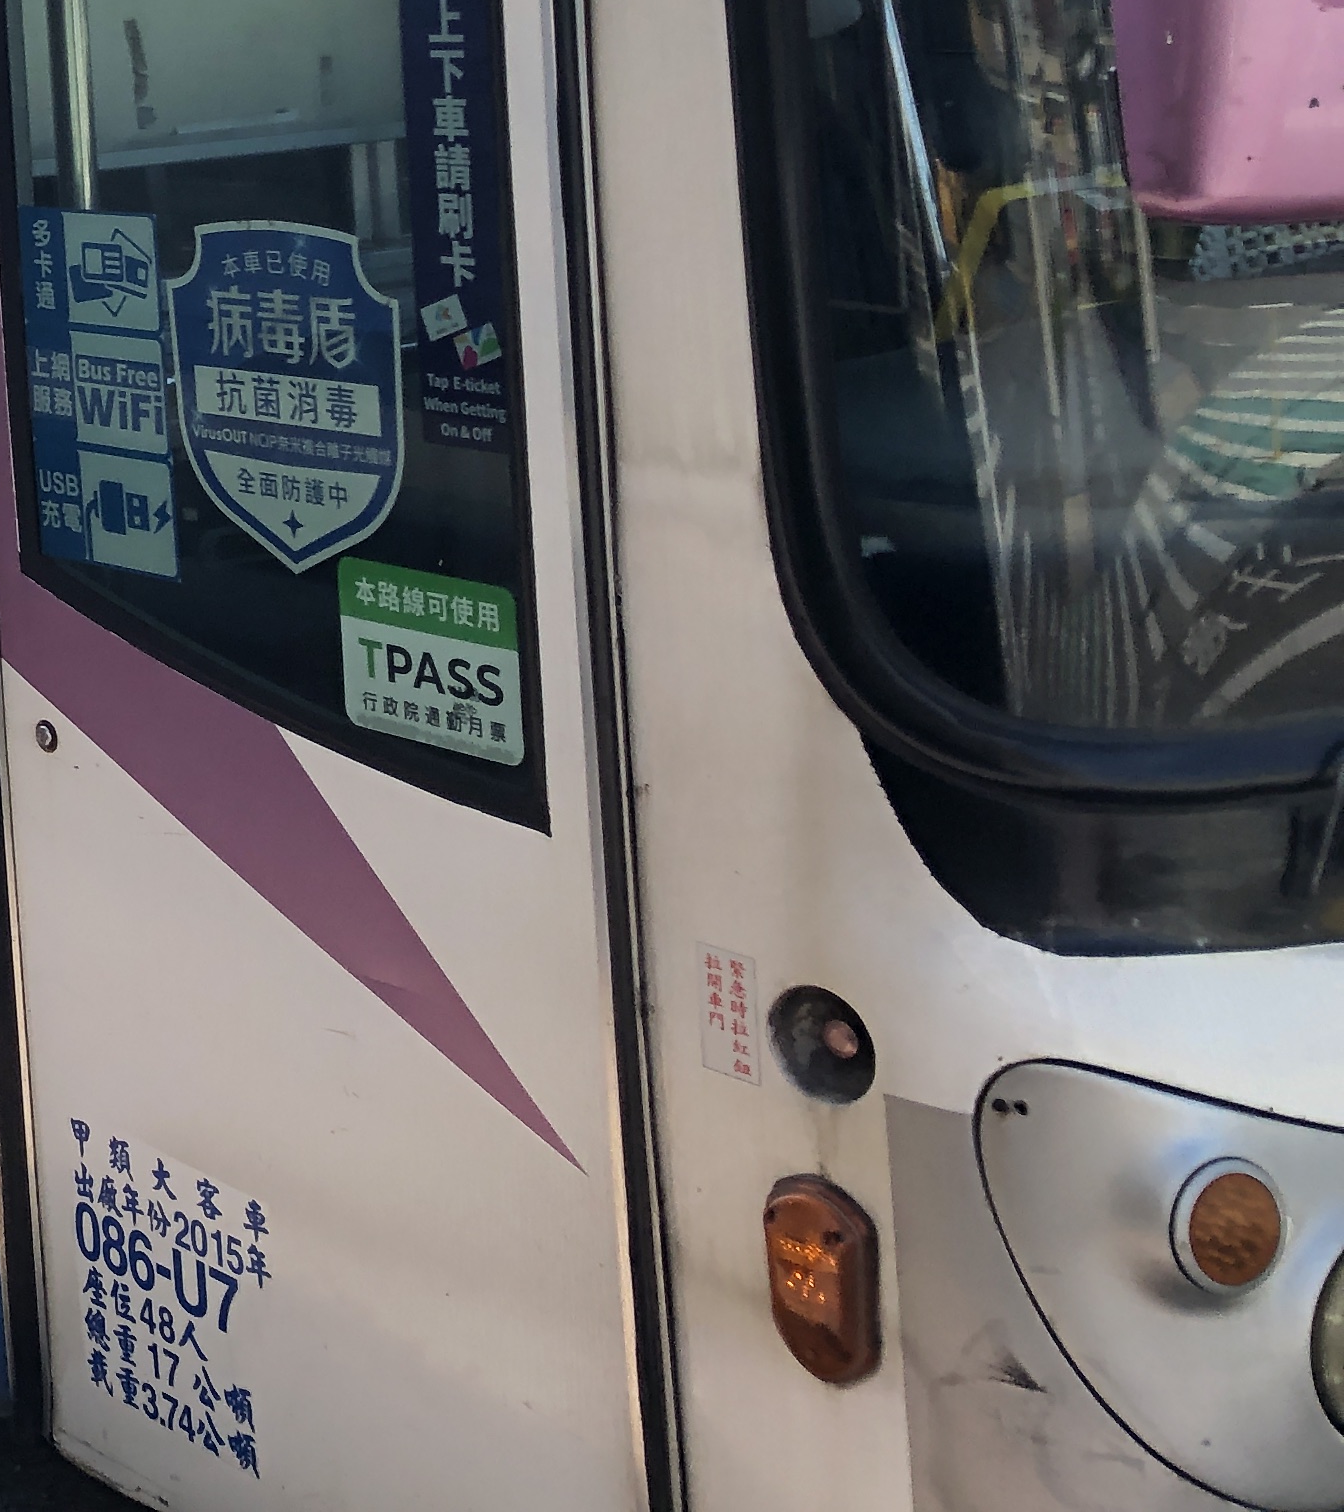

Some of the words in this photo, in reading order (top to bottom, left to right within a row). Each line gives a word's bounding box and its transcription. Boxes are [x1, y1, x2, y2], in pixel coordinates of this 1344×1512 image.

[31, 219, 57, 311] 多卡通
[221, 249, 332, 288] 本車已使用
[205, 284, 357, 369] 病毒盾
[30, 348, 71, 381] 上網
[78, 358, 111, 381] Bus
[116, 364, 159, 389] Free
[426, 372, 449, 390] Tap
[453, 376, 501, 395] E-ticket
[32, 384, 74, 418] 服務
[76, 384, 165, 436] WiFi
[215, 370, 358, 430] 抗菌消毒
[423, 396, 459, 414] When
[460, 401, 507, 424] Getting
[192, 423, 248, 446] VirusOUT
[440, 422, 459, 437] On
[460, 424, 471, 439] &
[472, 426, 494, 442] Off
[38, 468, 80, 498] USB
[236, 467, 349, 510] 全面防護中
[41, 499, 83, 535] 充電
[354, 576, 502, 633] 本路線可使用
[358, 637, 505, 708] TPASS
[69, 1117, 270, 1243] 甲類大客車
[74, 1201, 240, 1334] 086-U7
